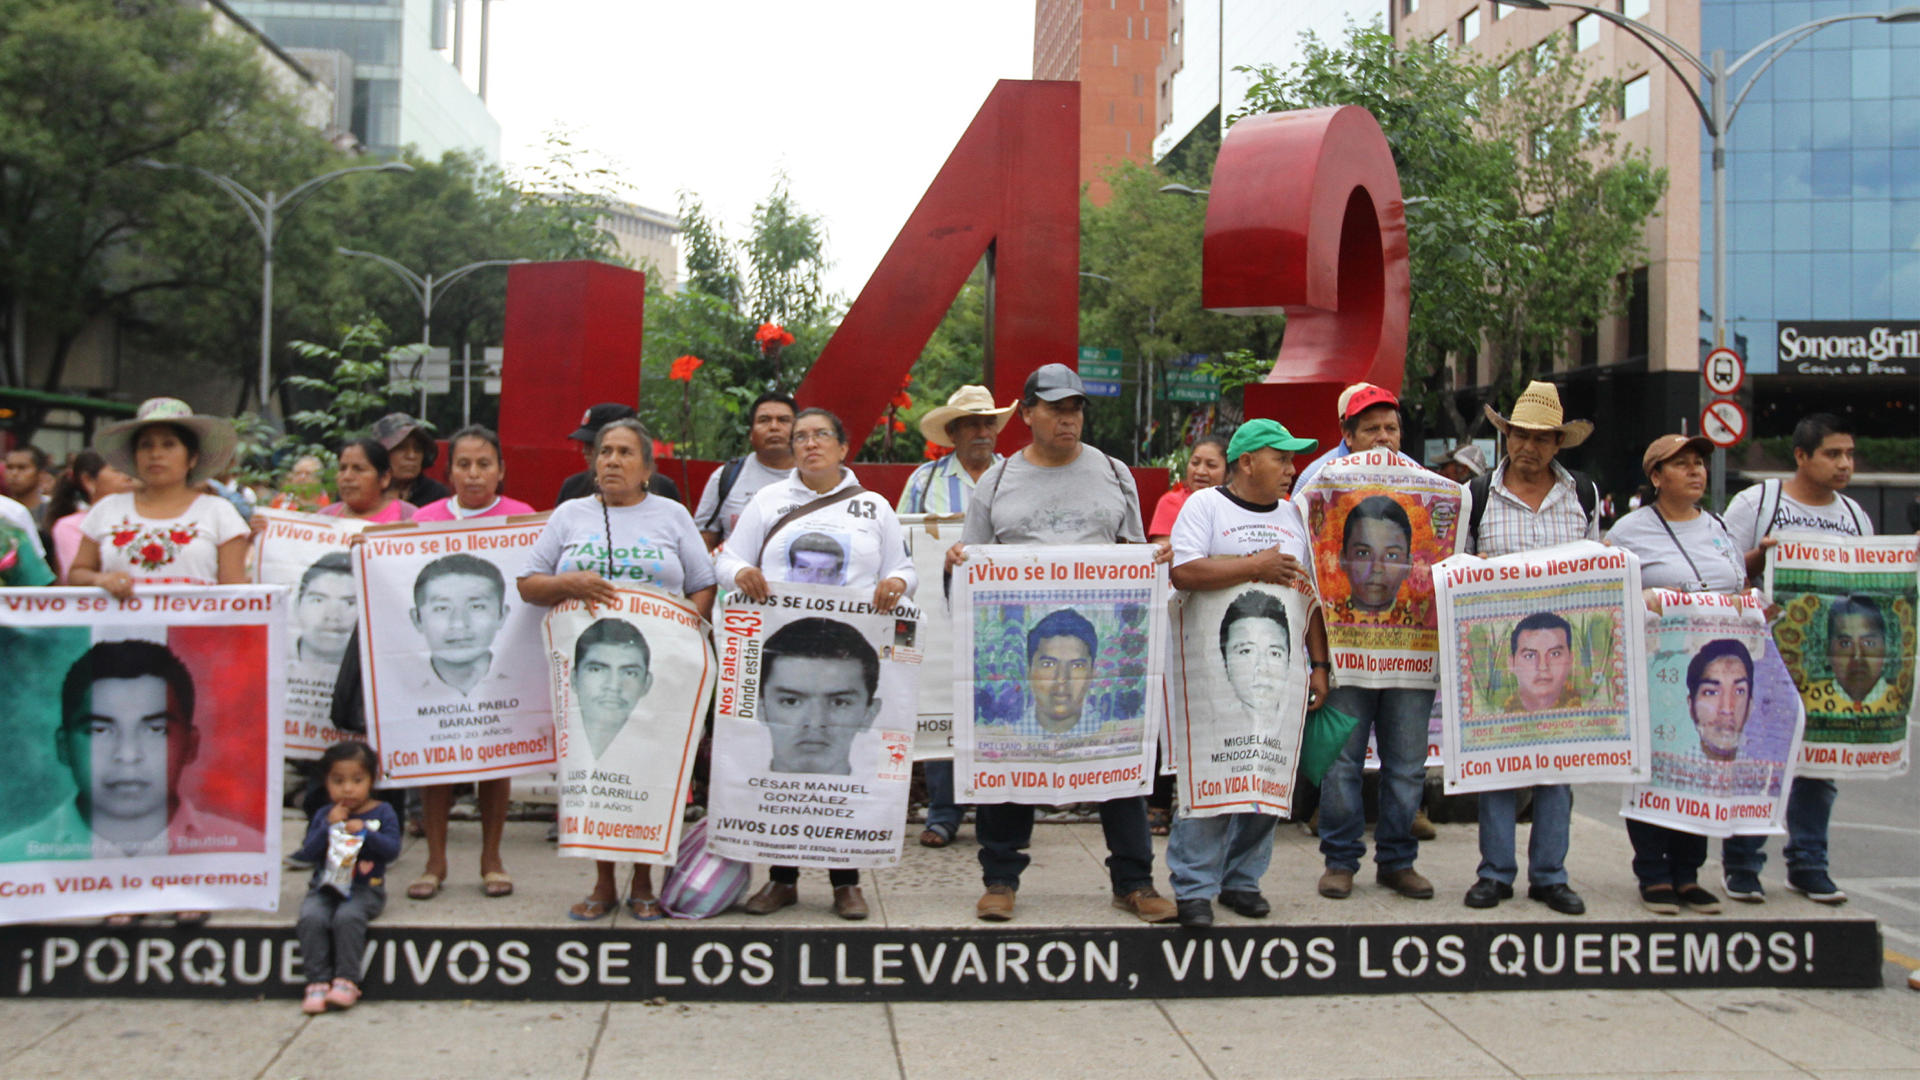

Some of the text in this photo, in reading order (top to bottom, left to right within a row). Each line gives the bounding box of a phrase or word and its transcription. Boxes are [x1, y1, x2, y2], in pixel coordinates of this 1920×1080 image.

[1779, 326, 1920, 362] Sonora gril
[1341, 455, 1361, 466] se
[1366, 453, 1382, 466] lo
[847, 499, 878, 520] 43
[268, 523, 314, 542] ¡Vivo
[317, 531, 336, 544] se
[367, 540, 416, 559] ¡Vivo
[420, 540, 440, 554] se
[446, 536, 462, 552] lo
[1777, 543, 1820, 562] ¡Vivo
[1823, 548, 1836, 562] se
[1839, 547, 1850, 564] lo
[968, 561, 1156, 584] ¡Vivo se lo llevaron!
[1447, 552, 1626, 588] ¡Vivo se lo llevaron!
[77, 595, 109, 612] se
[154, 594, 272, 612] llevaron!
[782, 596, 802, 609] SE
[806, 598, 835, 612] LOS
[1696, 593, 1714, 607] se
[724, 609, 762, 638] 43!
[1334, 653, 1434, 675] VIDA lo queremos!
[738, 639, 760, 719] Dónde están
[1656, 668, 1680, 684] 43
[418, 697, 520, 717] MARCIAL PABLO
[719, 686, 733, 715] Nos
[304, 721, 317, 738] lo
[439, 714, 501, 729] BARANDA
[1471, 726, 1495, 738] JOSÉ
[1501, 723, 1531, 734] ÁNGEL
[1580, 717, 1619, 727] CANTOR
[1654, 723, 1677, 740] 43
[430, 734, 461, 742] EDAD
[482, 726, 514, 737] AÑOS
[1224, 734, 1263, 748] MIGUEL
[388, 735, 548, 770] ¡Con VIDA lo queremos!
[978, 741, 1022, 751] EMILIANO
[1211, 748, 1260, 763] MENDOZA
[1805, 747, 1838, 764] VIDA
[1231, 764, 1253, 773] EDAD
[1461, 760, 1492, 779] ¡Con
[1497, 755, 1533, 773] VIDA
[1536, 753, 1550, 769] lo
[1553, 749, 1632, 771] queremos!
[590, 768, 632, 785] ÁNGEL
[748, 777, 870, 795] CÉSAR MANUEL
[974, 763, 1143, 790] ¡Con VIDA lo queremos!
[591, 785, 649, 802] CARRILLO
[1197, 779, 1222, 800] ¡Con
[1225, 775, 1250, 795] VIDA
[1252, 774, 1261, 792] lo
[603, 801, 634, 812] AÑOS
[763, 790, 849, 806] GONZÁLEZ
[1639, 791, 1729, 821] ¡Con VIDA lo
[758, 803, 855, 819] HERNÁNDEZ
[583, 815, 663, 842] lo queremos!
[717, 816, 894, 842] ¡VIVOS LOS QUEREMOS!
[752, 839, 797, 850] TERRORISMO
[799, 843, 809, 851] DE
[55, 875, 113, 894] VIDA
[122, 875, 143, 889] lo
[151, 871, 269, 890] queremos!
[18, 936, 307, 994] ¡PORQUE
[555, 941, 632, 986] SE
[655, 941, 775, 986] LOS
[800, 940, 1139, 991] LLEVARON,
[1161, 937, 1337, 982] VIVOS
[1358, 934, 1467, 979] LOS
[1488, 930, 1815, 978] QUEREMOS!
